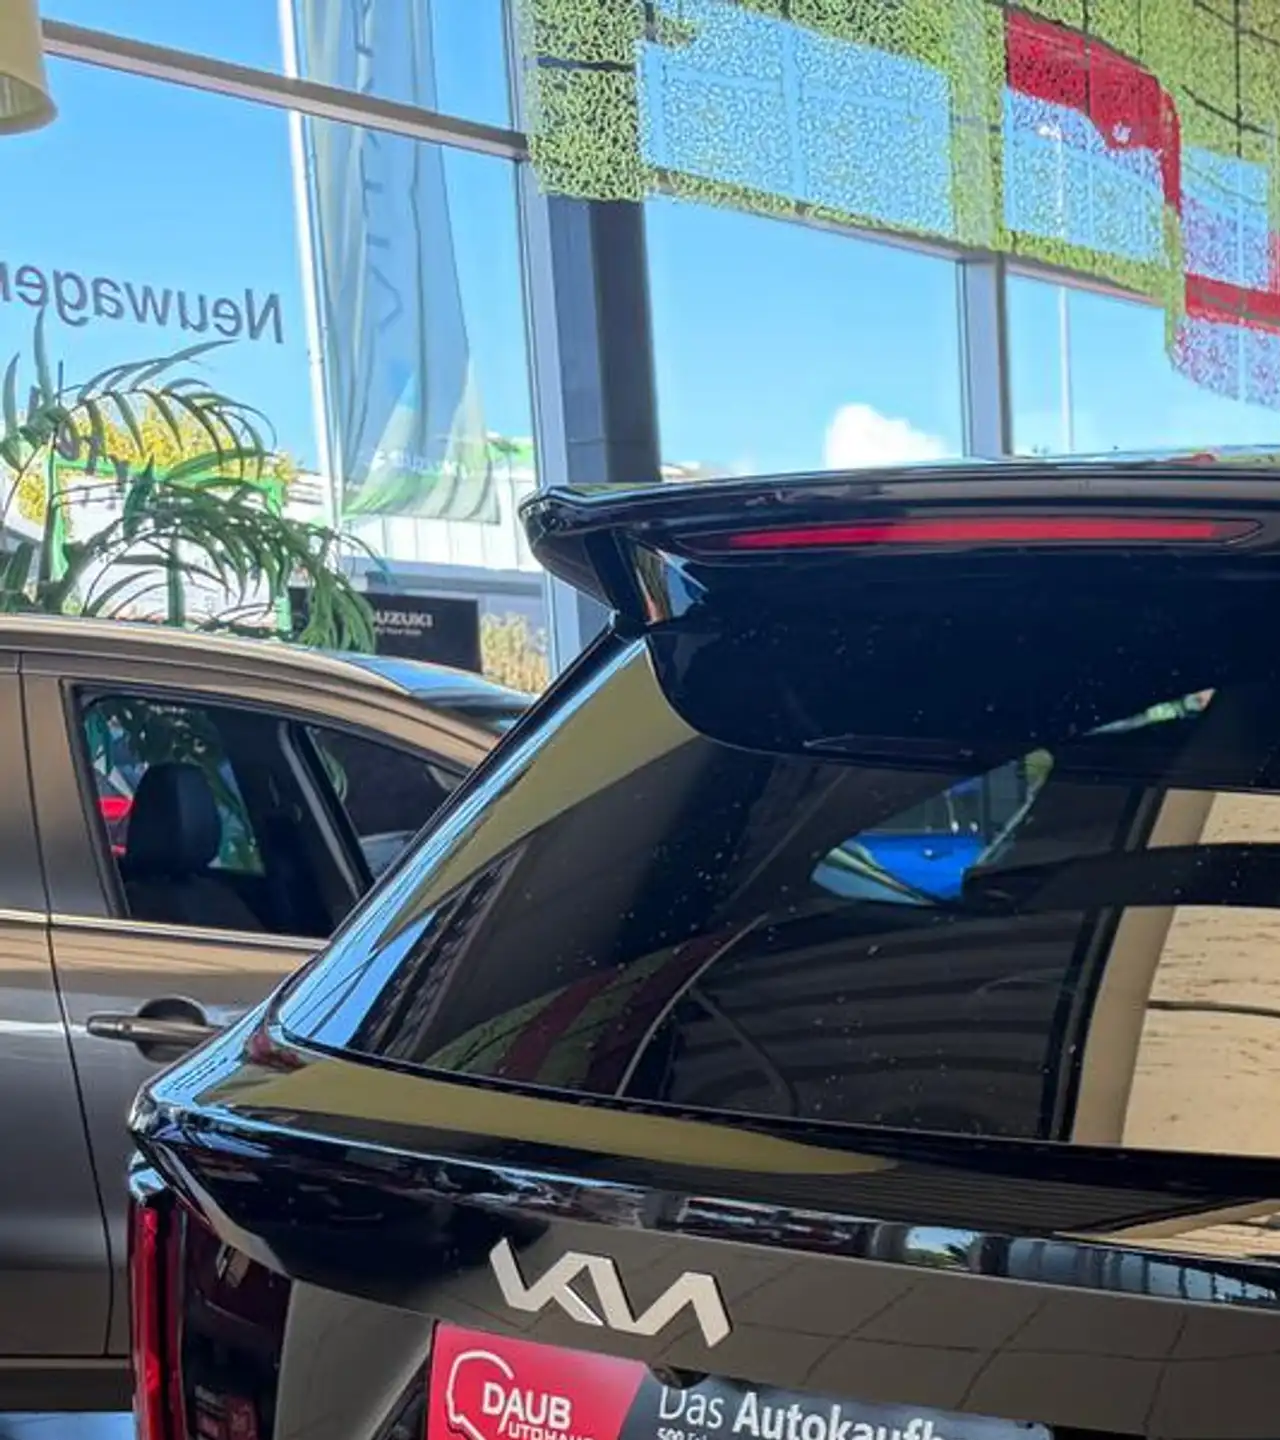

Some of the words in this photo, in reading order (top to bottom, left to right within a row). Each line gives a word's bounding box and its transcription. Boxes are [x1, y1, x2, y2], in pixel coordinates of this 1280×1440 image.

[375, 609, 434, 629] UZUKI
[489, 1237, 733, 1348] KIA
[481, 1381, 573, 1434] DAUB
[658, 1384, 725, 1430] Das
